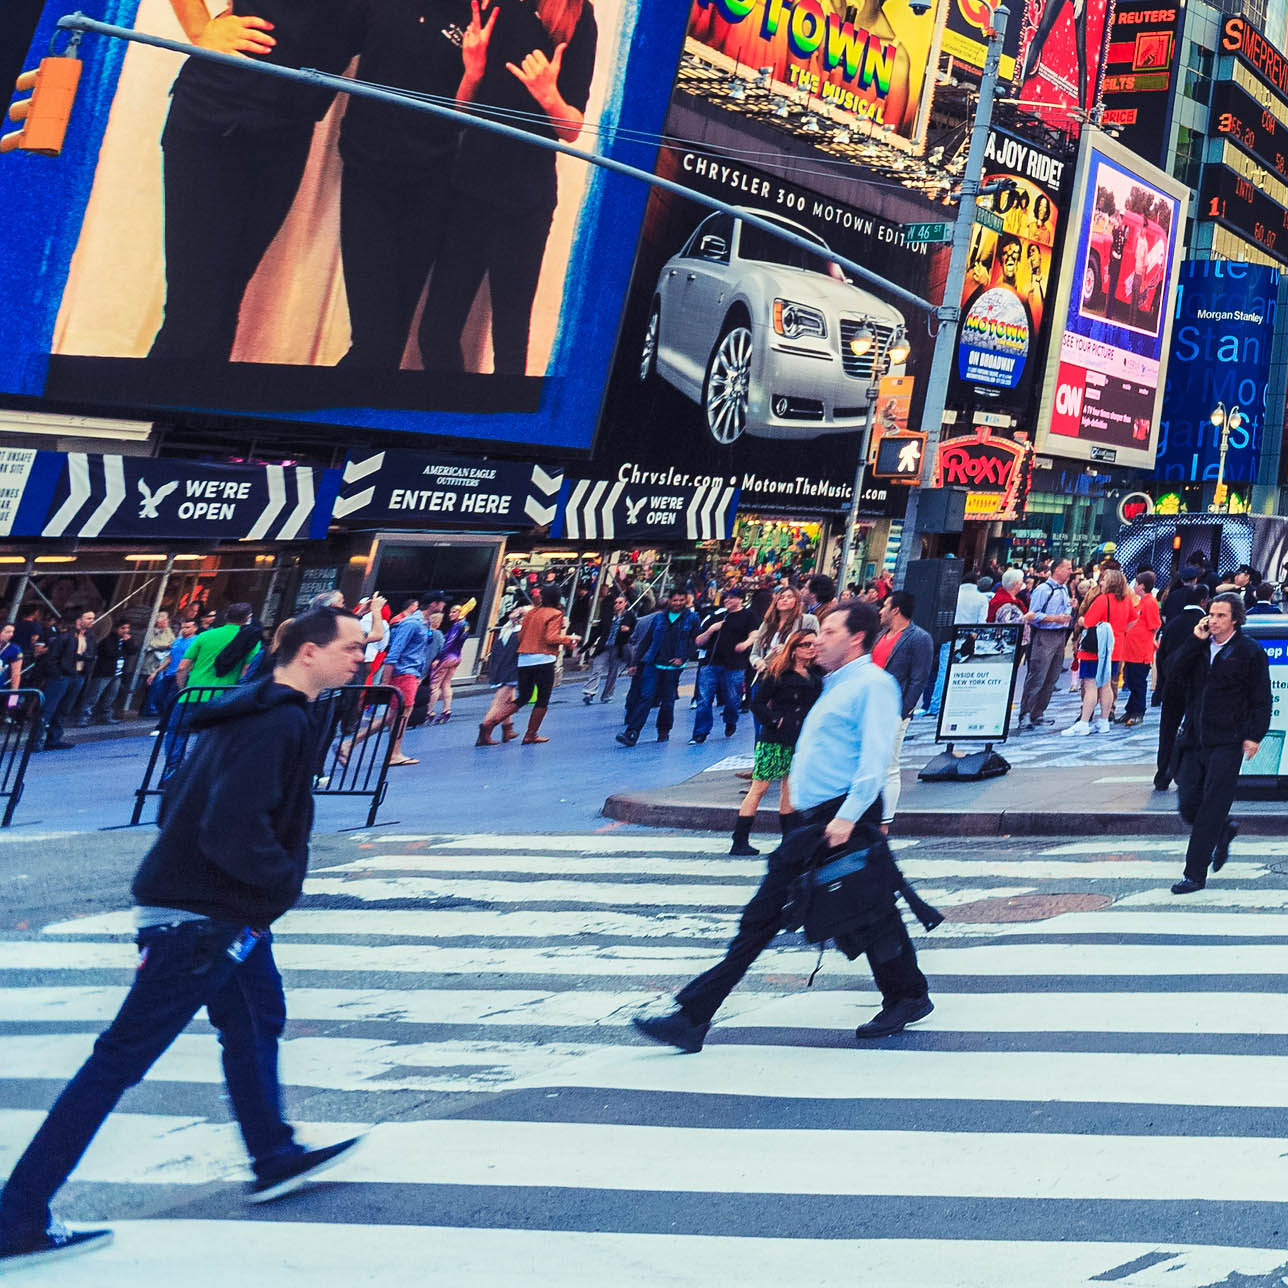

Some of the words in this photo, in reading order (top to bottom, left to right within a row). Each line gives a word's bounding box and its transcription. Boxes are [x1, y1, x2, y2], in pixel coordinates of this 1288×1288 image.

[1118, 9, 1176, 25] REUTERS
[789, 64, 819, 93] THE
[822, 81, 884, 125] MUSICAL
[1102, 112, 1134, 123] PRICE
[683, 153, 770, 198] CHRYSLER
[777, 189, 806, 212] 300
[813, 203, 873, 235] MOTOWN
[918, 226, 930, 240] 46
[934, 224, 942, 232] ST
[1197, 310, 1233, 321] Morgan
[1234, 310, 1263, 325] Stanley
[965, 314, 1028, 344] MOTOWN
[1063, 334, 1075, 347] SEE
[1076, 337, 1091, 353] YOUR
[1092, 343, 1116, 361] PICTURE
[968, 350, 979, 366] ON
[980, 352, 1016, 372] BROADWAY
[1056, 384, 1083, 418] CNN
[423, 465, 468, 477] AMERICAN
[469, 468, 497, 479] EAGLE
[943, 448, 1013, 485] ROXY
[184, 479, 251, 499] WE'RE
[436, 477, 480, 487] OUTFITTERS
[389, 489, 456, 511] ENTER
[460, 493, 512, 514] HERE
[649, 496, 684, 510] WE'RE
[178, 502, 236, 520] OPEN
[646, 511, 677, 526] OPEN
[1264, 647, 1283, 659] eep
